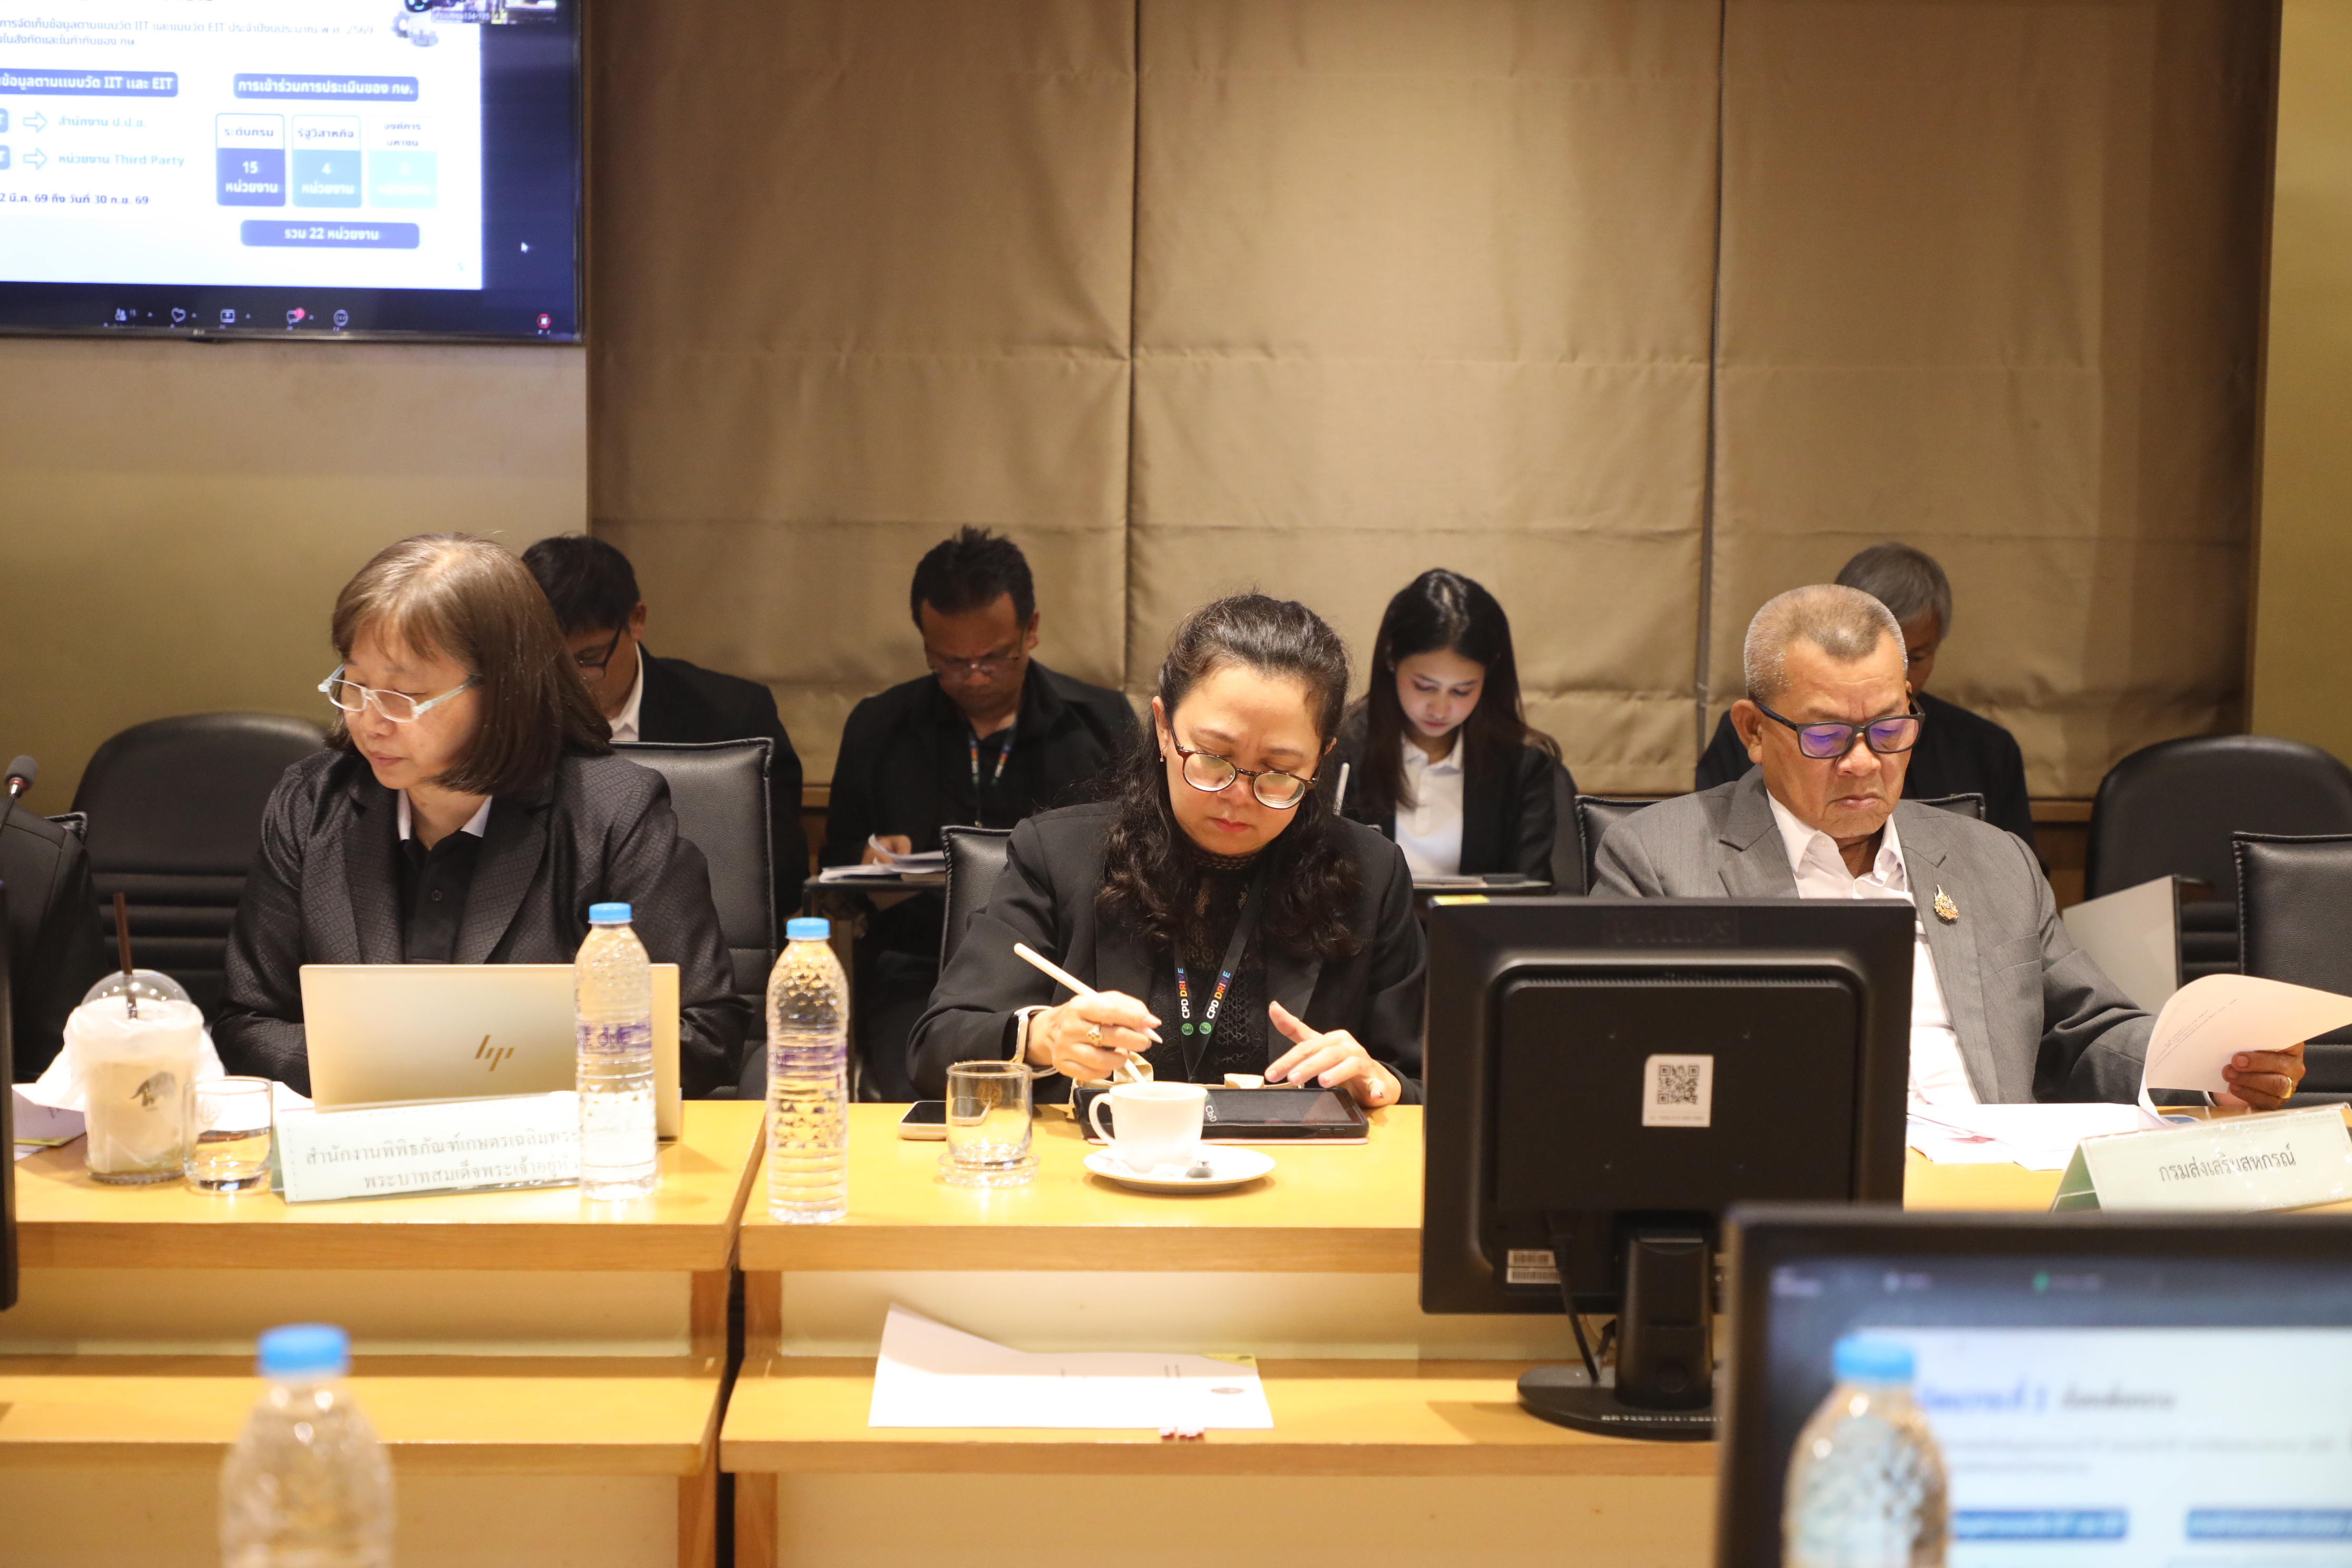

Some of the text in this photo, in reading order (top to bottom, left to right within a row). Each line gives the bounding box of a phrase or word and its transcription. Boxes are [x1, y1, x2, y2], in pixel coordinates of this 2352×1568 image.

[135, 21, 150, 30] IIT
[209, 23, 224, 32] EIT
[0, 73, 173, 90] ข้อมูลตามแบบวัด IIT และ EIT
[58, 115, 109, 127] สำนักงาน
[224, 127, 274, 137] ระดับกรม
[58, 152, 185, 168] หน่วยงาน Third Party
[242, 161, 258, 174] 15
[321, 162, 330, 174] 4
[226, 179, 278, 193] หน่วยงาน
[301, 180, 354, 194] หน่วยงาน
[34, 193, 48, 203] 69
[52, 192, 65, 203] ถึง
[94, 194, 107, 204] 30
[135, 195, 149, 205] 69
[285, 227, 379, 240] รวม 22 หน่วยงาน
[1178, 967, 1190, 1018] CPD DRIVE
[1207, 971, 1231, 1019] CPD DRIVE
[306, 1128, 581, 1165] สำนักงานพิพิธภัณฑ์เกษตรเฉลิมพระ
